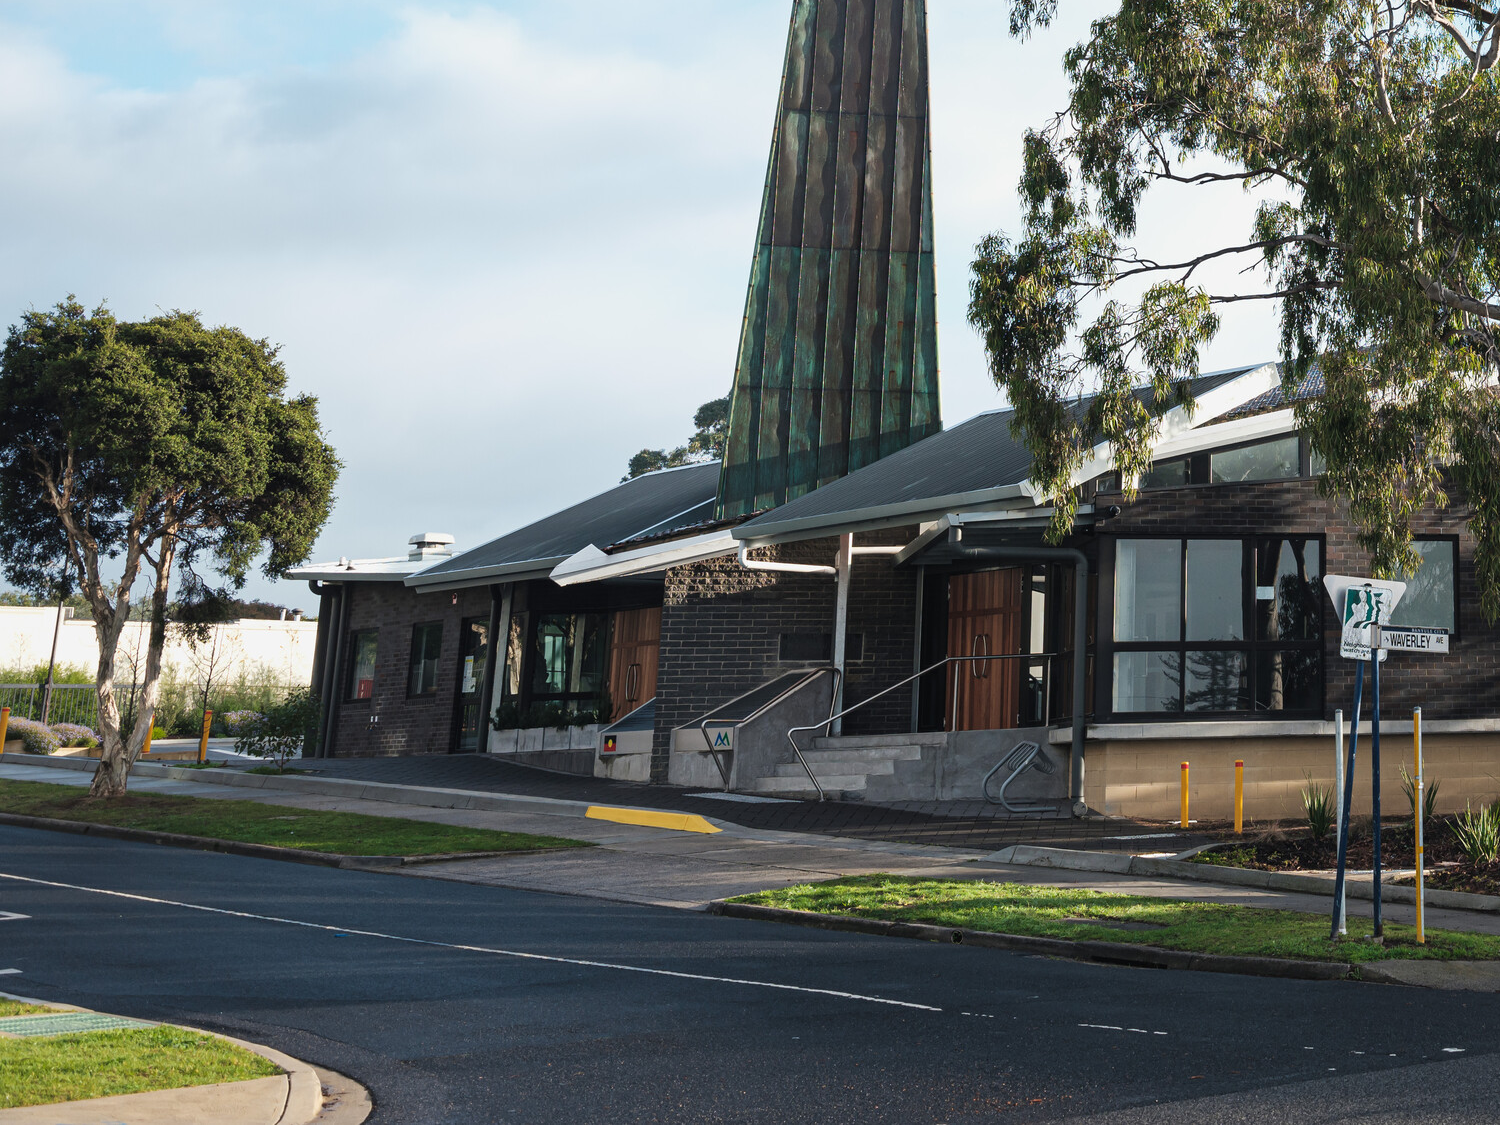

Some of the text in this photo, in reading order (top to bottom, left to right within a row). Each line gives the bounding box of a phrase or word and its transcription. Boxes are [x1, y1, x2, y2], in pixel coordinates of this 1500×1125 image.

[1343, 640, 1370, 649] Neighbou
[1390, 633, 1444, 648] WAVERLEY AVE
